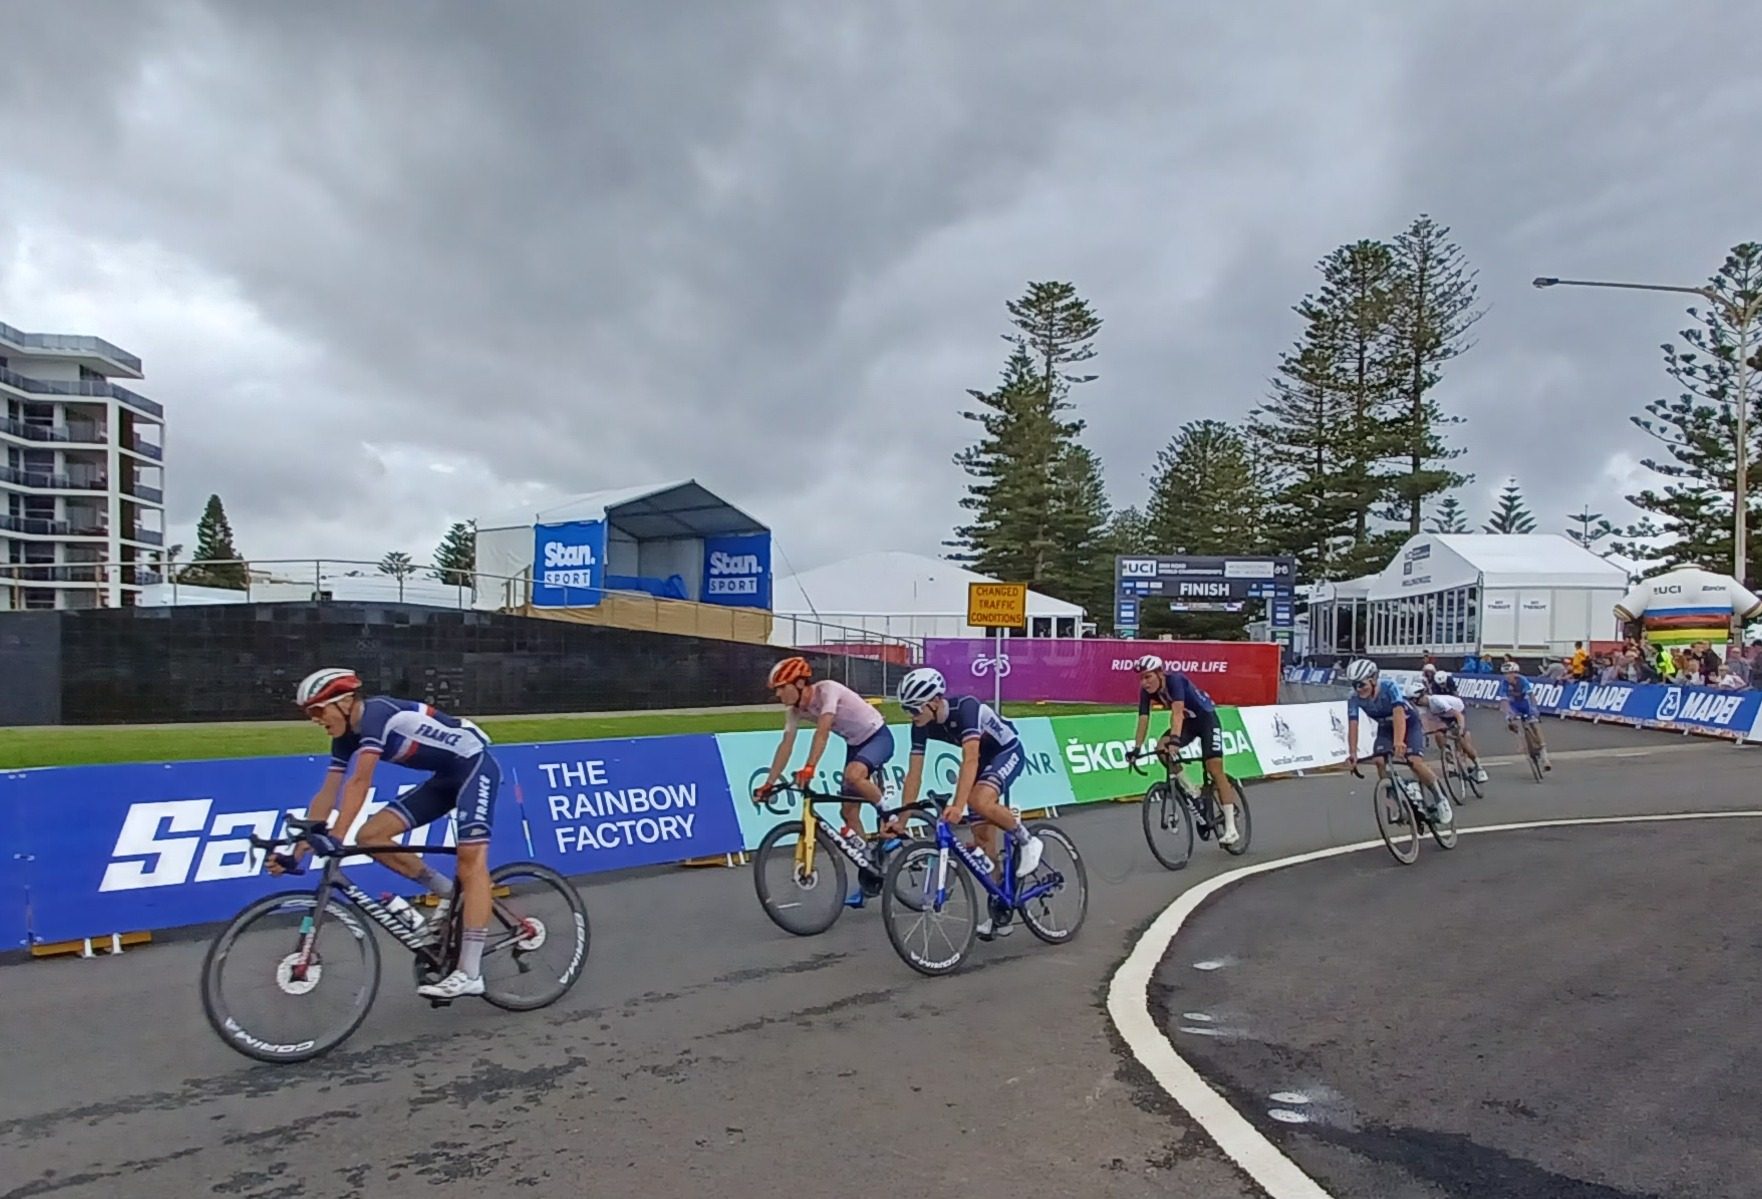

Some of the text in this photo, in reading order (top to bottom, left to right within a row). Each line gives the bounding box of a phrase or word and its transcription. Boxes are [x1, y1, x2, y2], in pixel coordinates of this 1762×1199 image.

[544, 541, 596, 567] Stan.
[709, 551, 763, 576] Stan.
[1128, 563, 1154, 574] UCI
[545, 571, 590, 586] SPORT
[709, 580, 756, 593] SPORT
[976, 587, 1019, 597] CHANGED
[1180, 583, 1230, 596] FINISH
[1658, 585, 1682, 594] UCI
[979, 599, 1016, 610] TRAFFIC
[971, 612, 1022, 623] CONDITIONS
[1165, 659, 1199, 673] YOUR
[1201, 661, 1229, 673] LIFE
[415, 724, 462, 746] FRANCE
[538, 760, 608, 789] THE
[474, 774, 491, 821] FRANCE
[548, 783, 697, 821] RAINBOW
[555, 813, 695, 853] FACTORY
